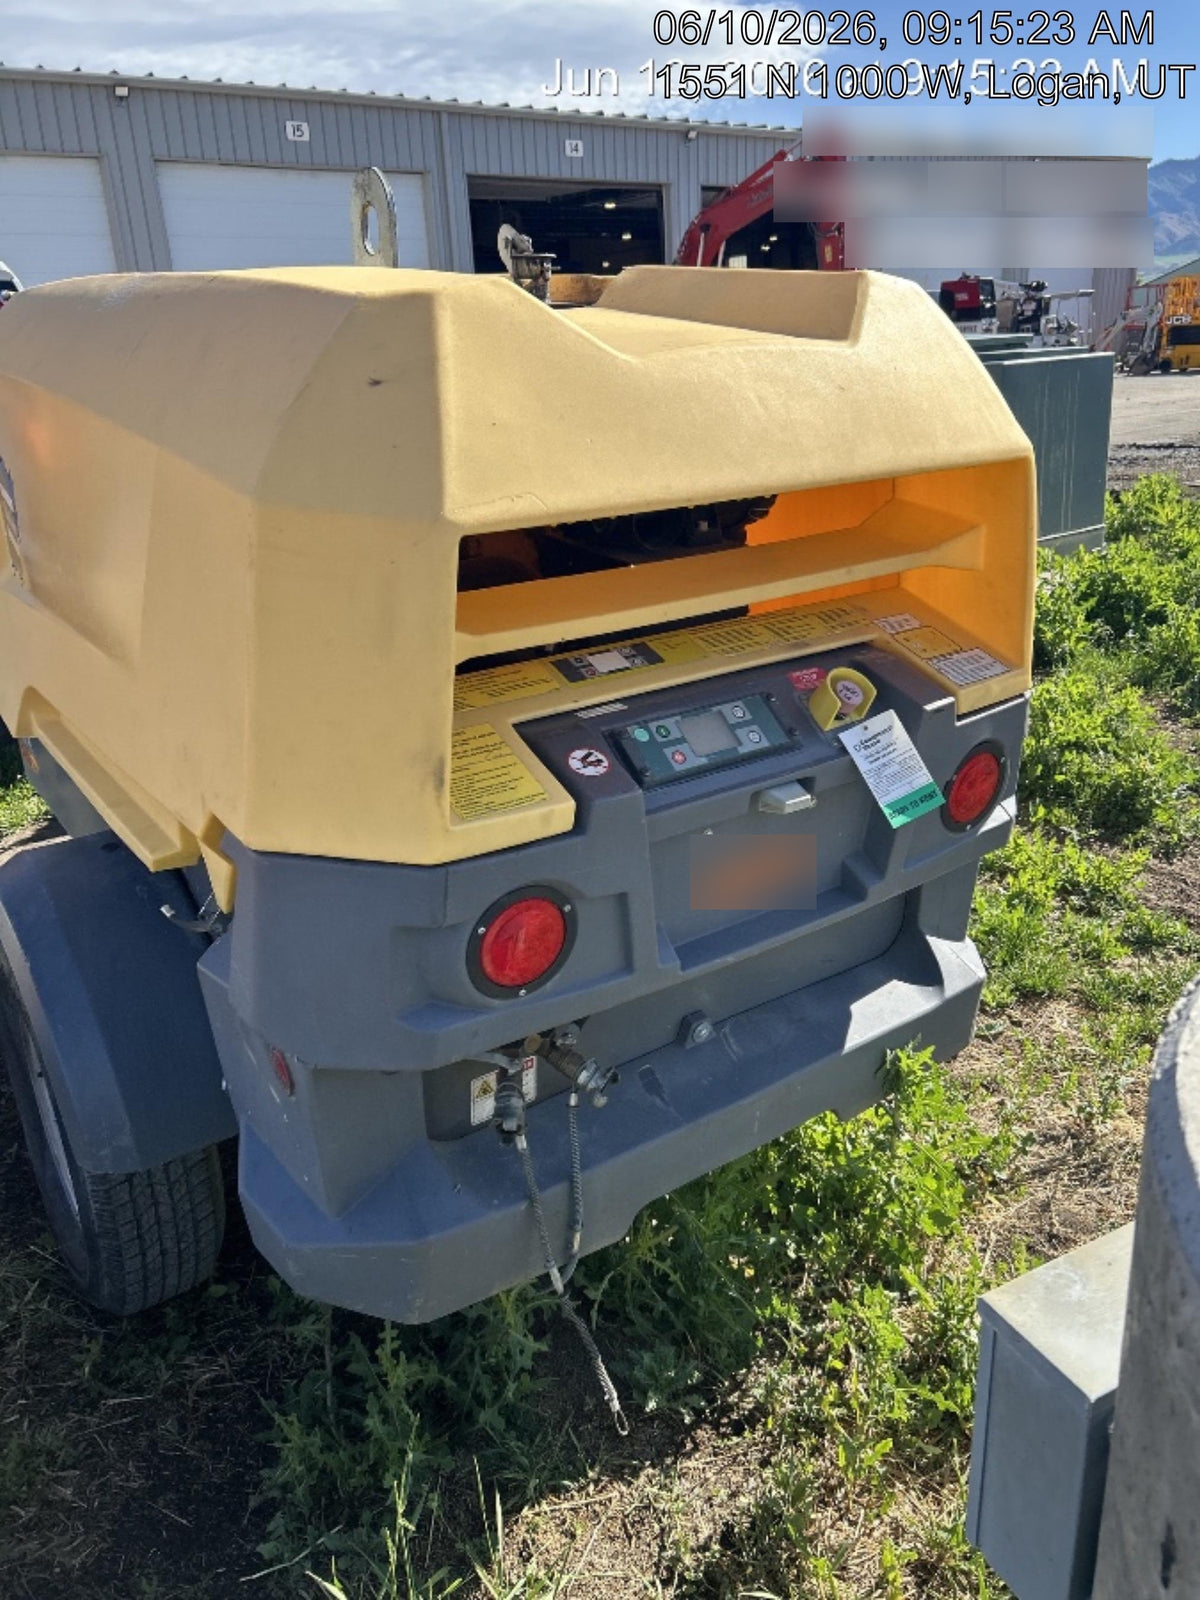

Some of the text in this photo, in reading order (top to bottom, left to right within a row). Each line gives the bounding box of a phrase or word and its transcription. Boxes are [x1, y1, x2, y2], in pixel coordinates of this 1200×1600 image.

[290, 123, 305, 138] 15
[568, 142, 579, 156] 14
[1166, 314, 1192, 325] JCB
